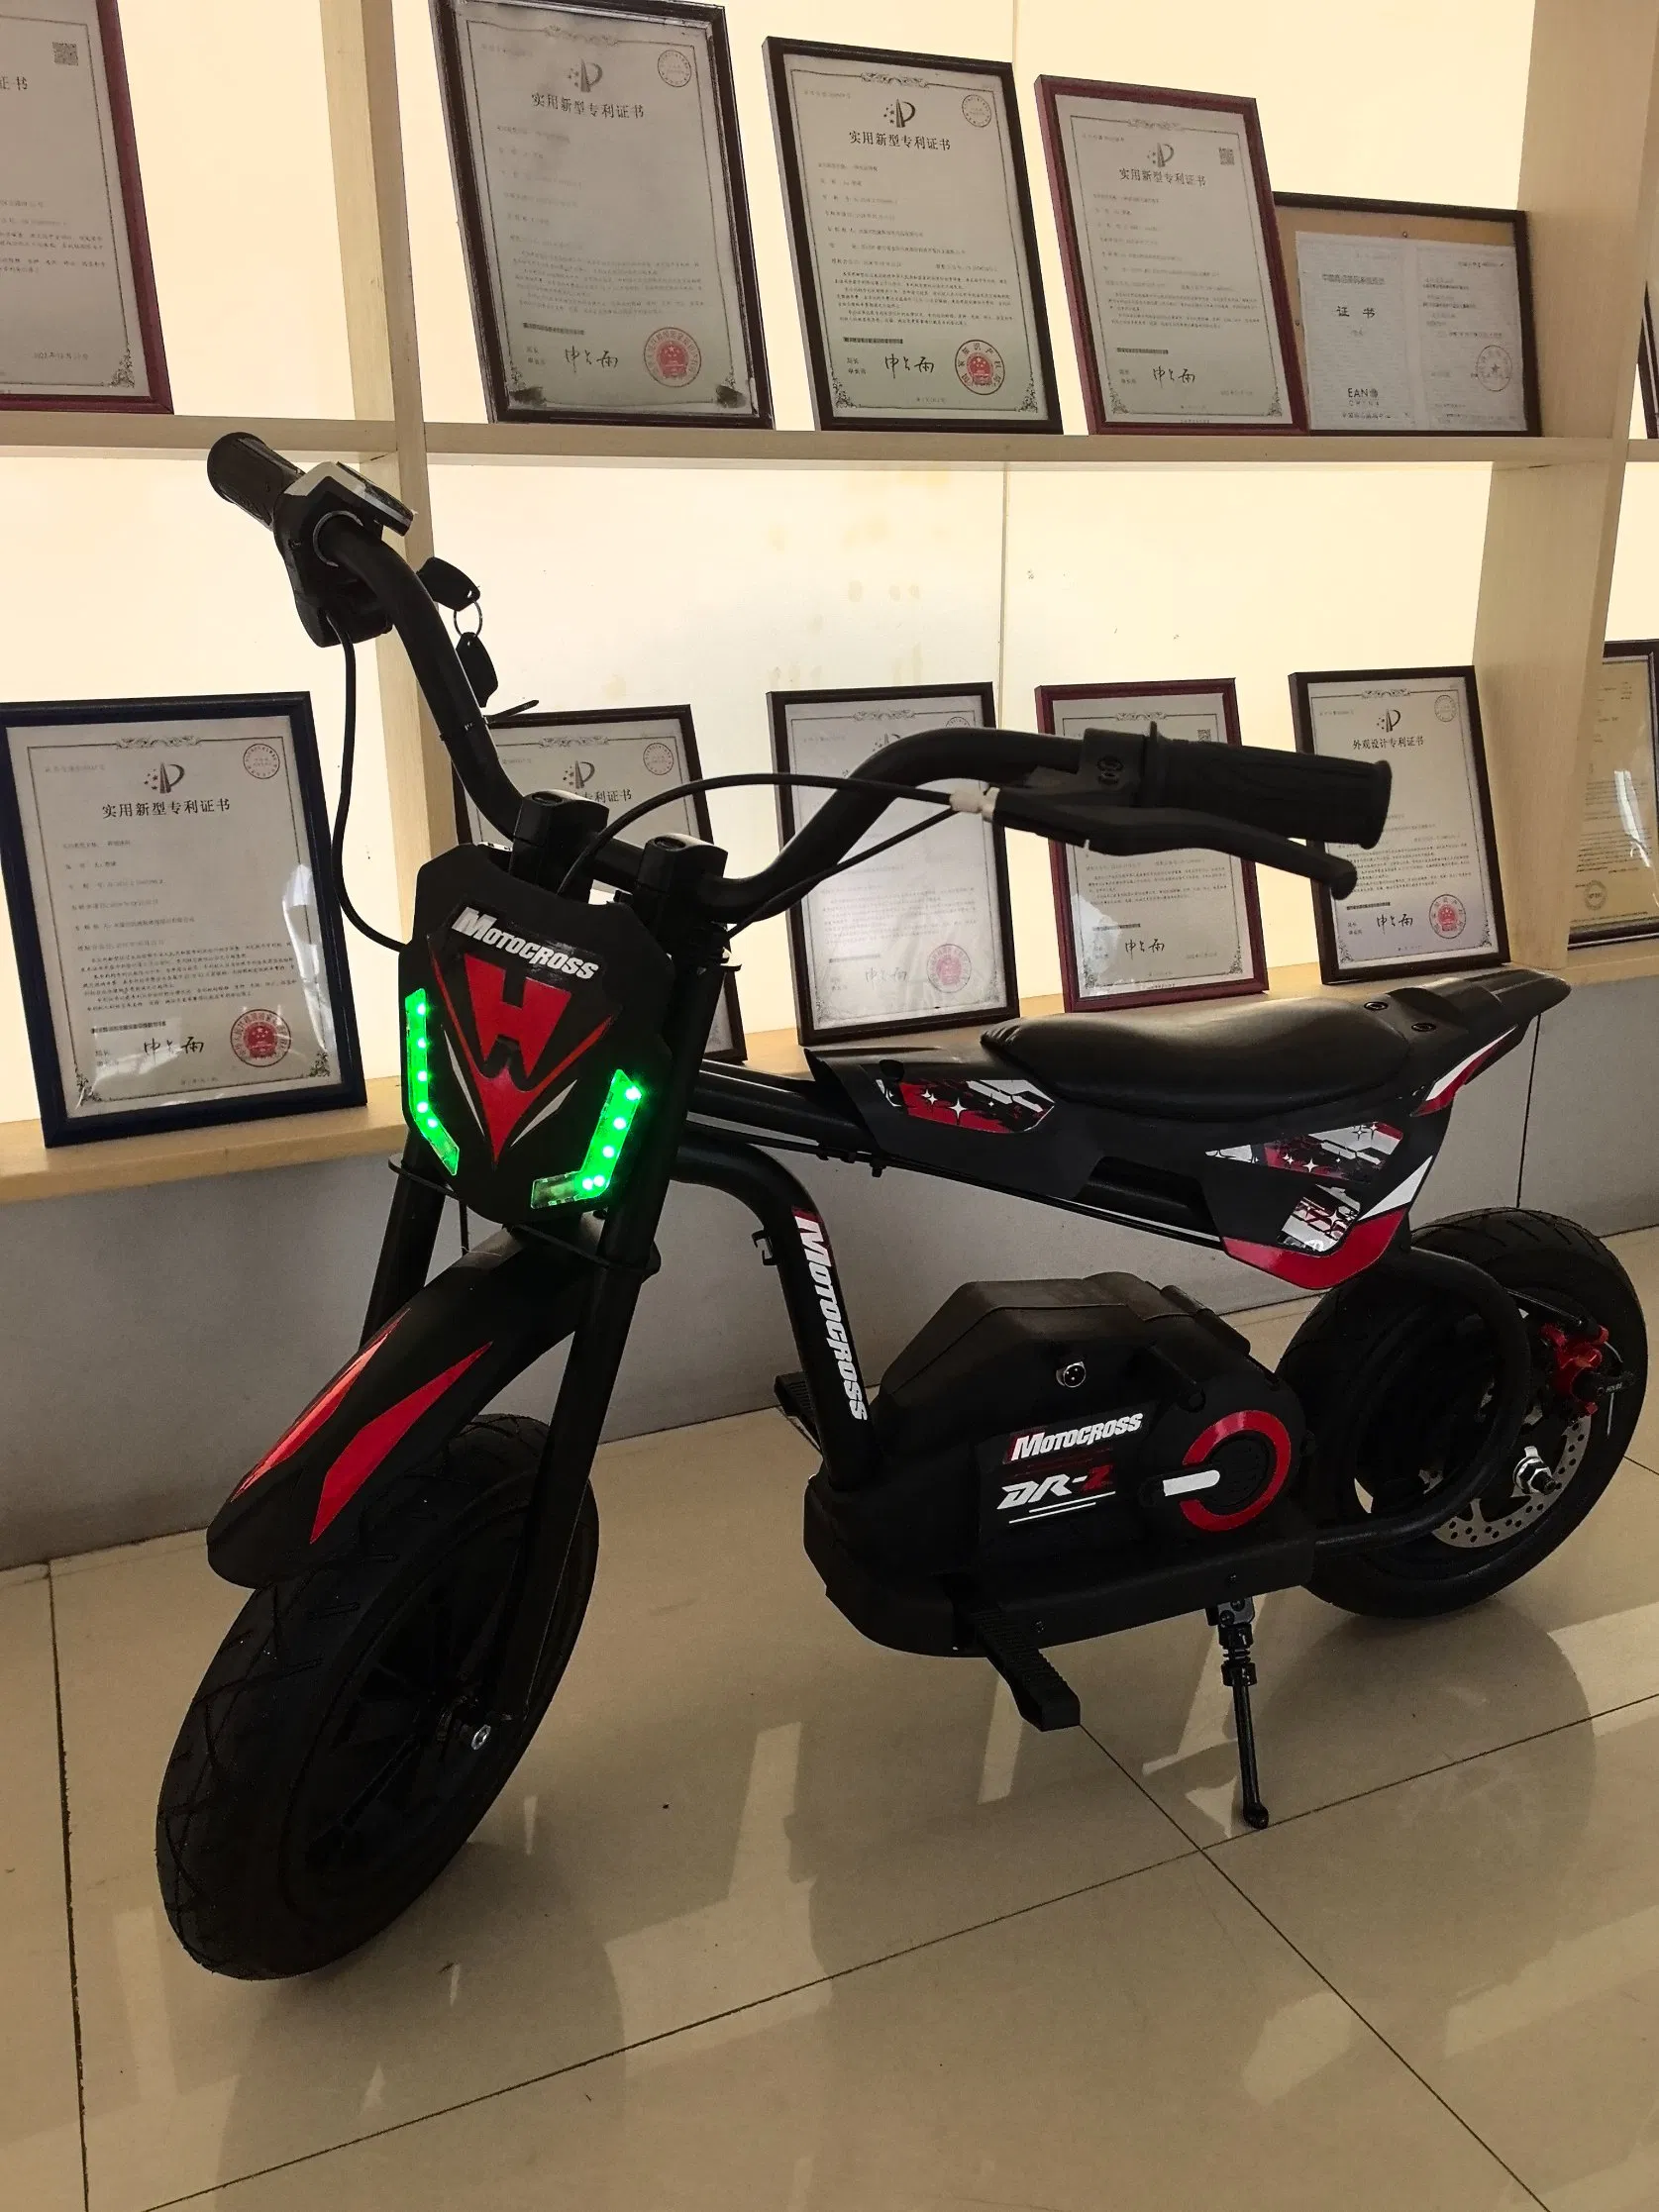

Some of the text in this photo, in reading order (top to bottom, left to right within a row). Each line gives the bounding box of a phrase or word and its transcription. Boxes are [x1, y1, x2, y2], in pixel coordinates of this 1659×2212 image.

[531, 92, 645, 120] 实用新型专利证书
[849, 130, 952, 151] 实用新型专利证书
[1118, 167, 1206, 187] 实用新型专利证书
[1336, 305, 1376, 319] 证书
[1347, 387, 1369, 398] EAN
[1353, 735, 1424, 751] 外观设计专利证书
[102, 797, 231, 820] 实用新型专利证书
[452, 906, 599, 979] MOTOCROSS
[794, 1215, 869, 1421] MOTOCROSS
[1010, 1412, 1144, 1461] MOTOCROSS
